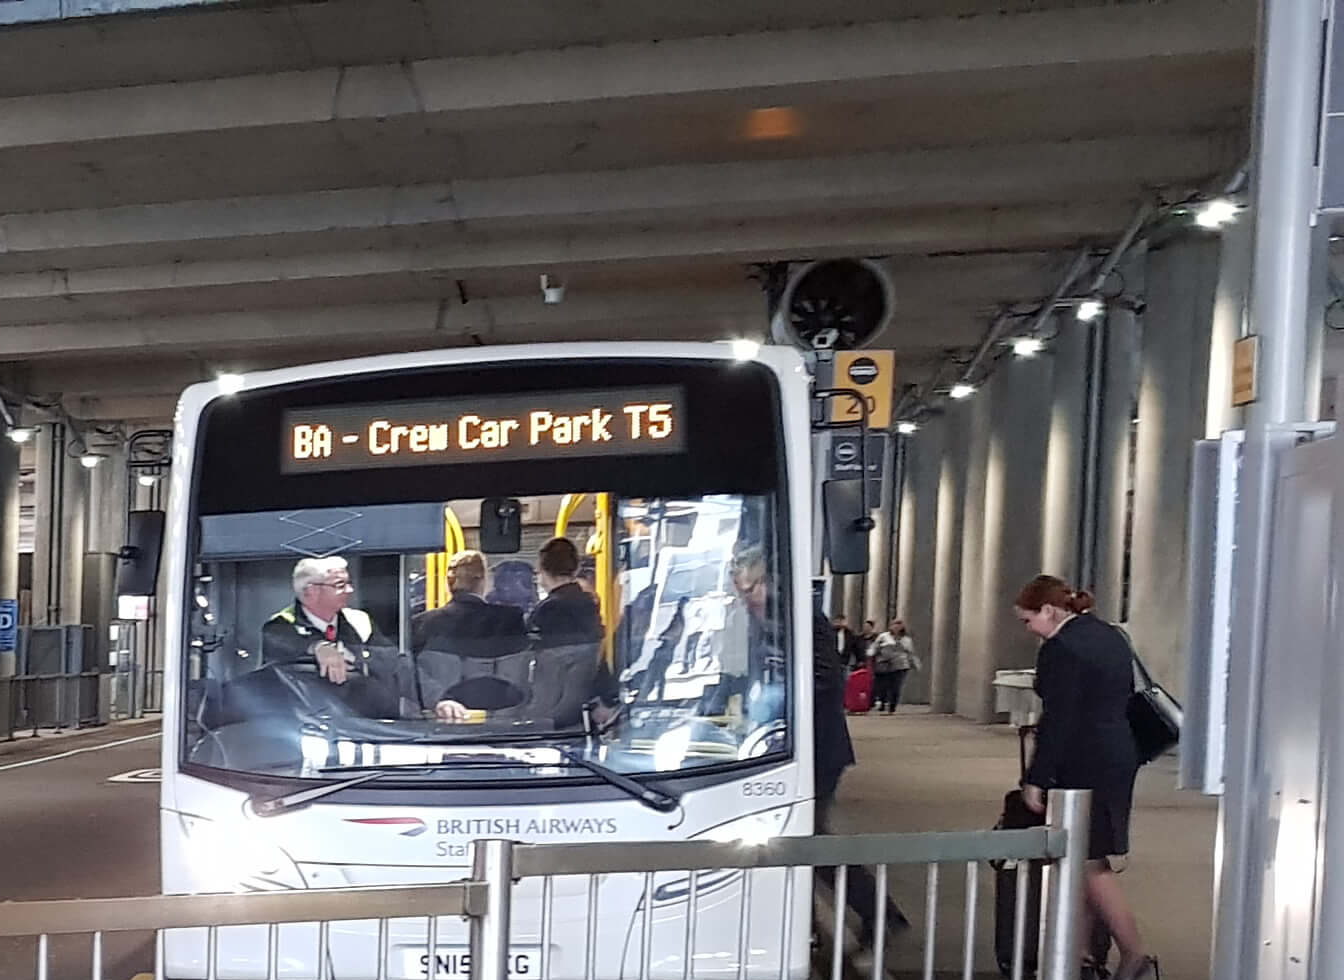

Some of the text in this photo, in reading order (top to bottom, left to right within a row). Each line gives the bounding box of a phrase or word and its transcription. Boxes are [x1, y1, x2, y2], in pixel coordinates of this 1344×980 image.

[293, 424, 332, 459] BA
[368, 420, 448, 455] Crew
[457, 414, 519, 450] Car
[529, 408, 612, 446] Park
[623, 403, 673, 440] T5
[743, 782, 786, 796] 8360
[436, 818, 617, 834] BRITISH AIRWAYS
